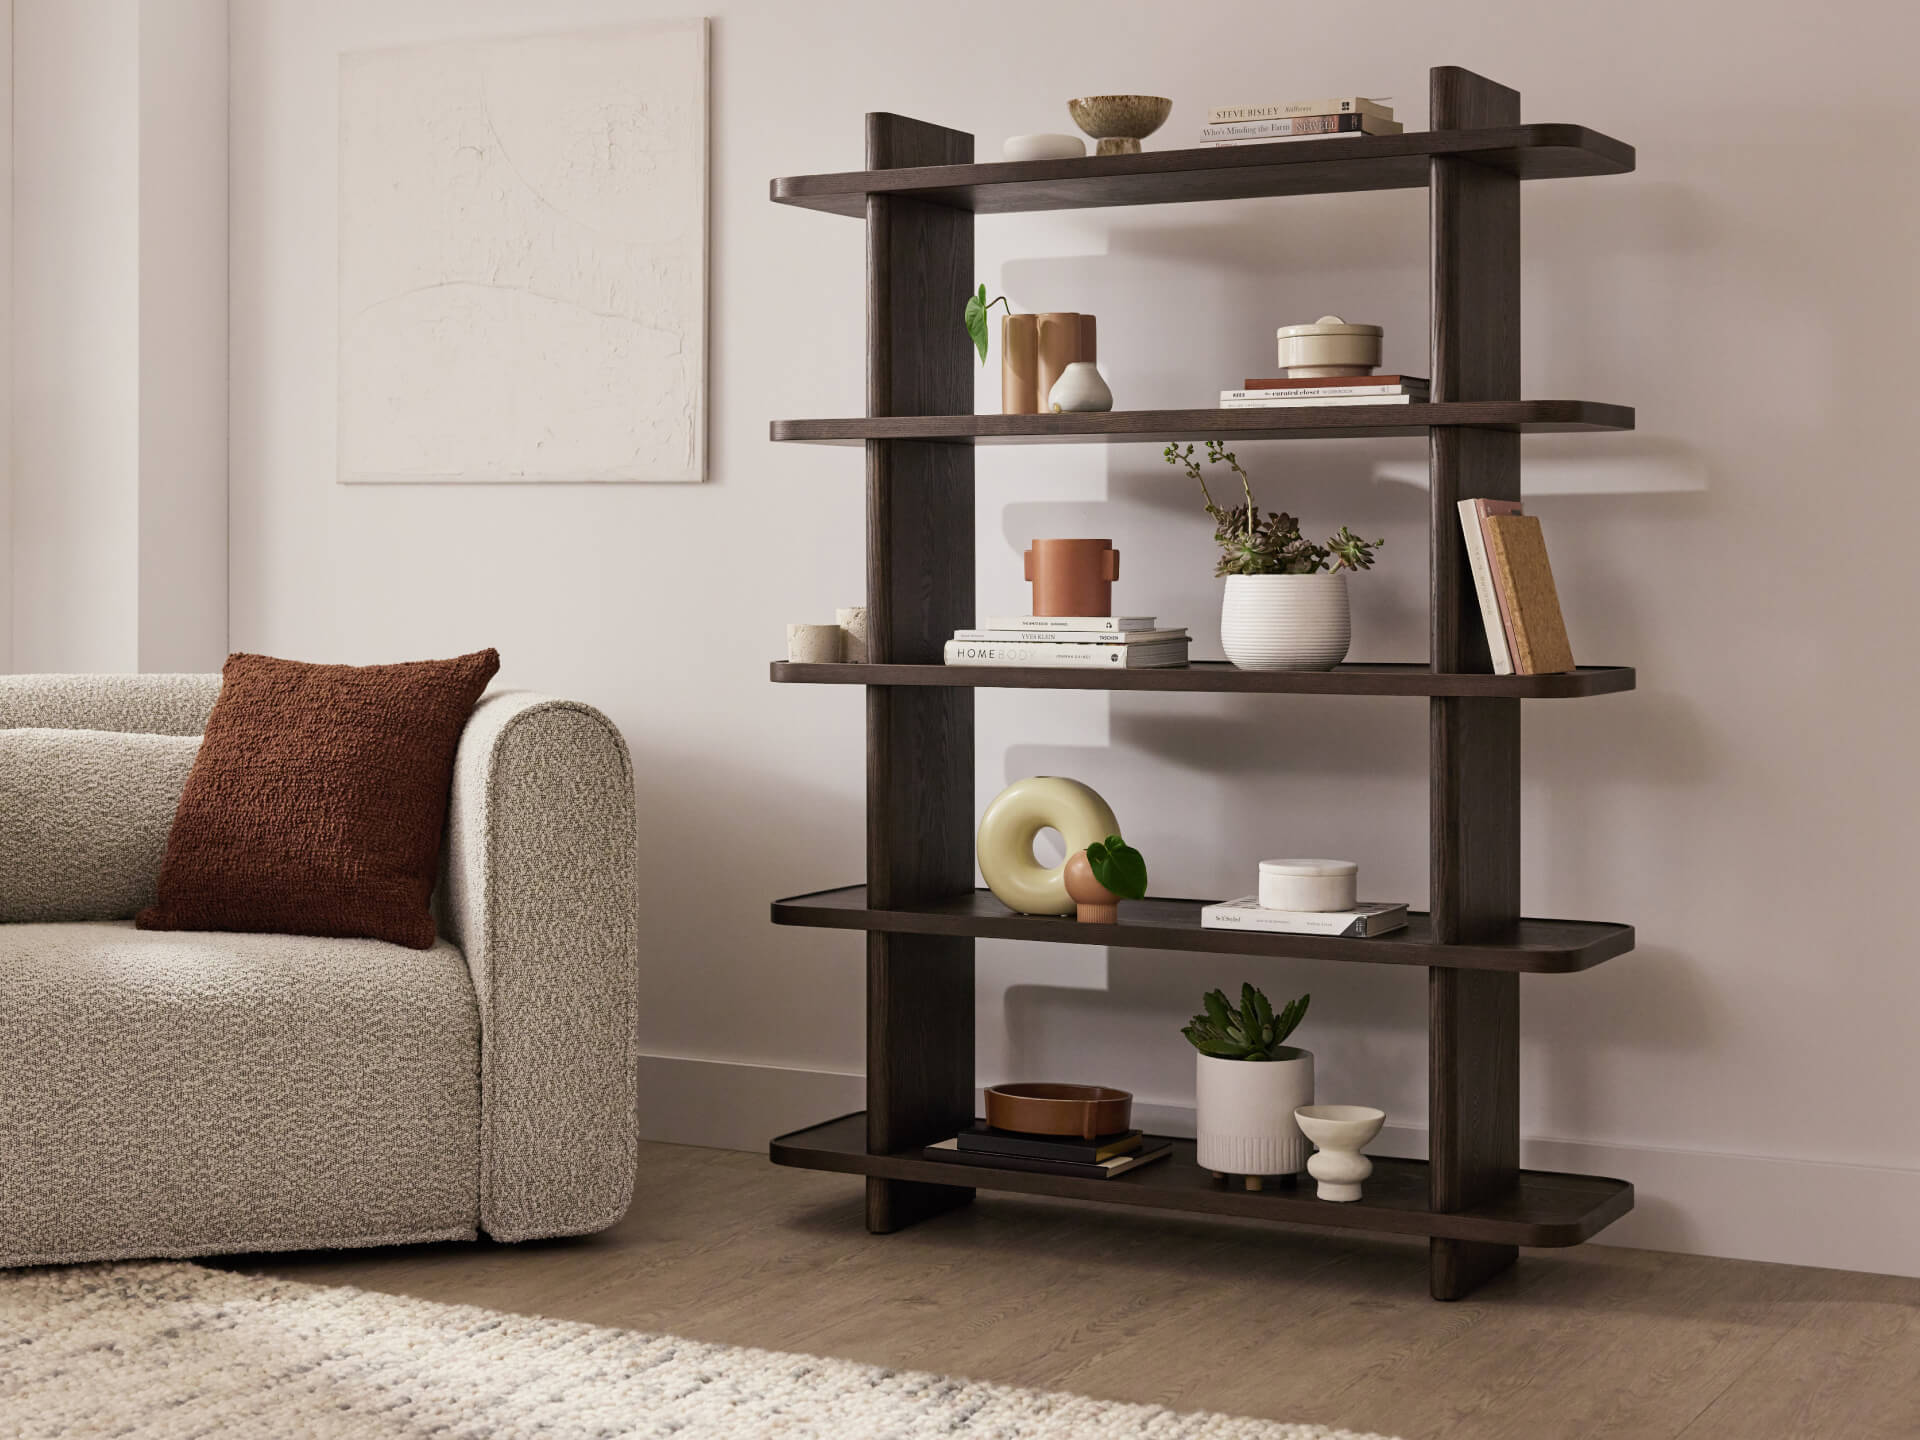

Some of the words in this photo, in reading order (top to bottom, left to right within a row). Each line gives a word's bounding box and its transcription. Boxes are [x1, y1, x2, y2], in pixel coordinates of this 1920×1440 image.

[1215, 110, 1243, 119] STEVE
[1247, 106, 1279, 117] BISLEY
[1225, 124, 1257, 136] Minding
[1271, 122, 1290, 131] Farm
